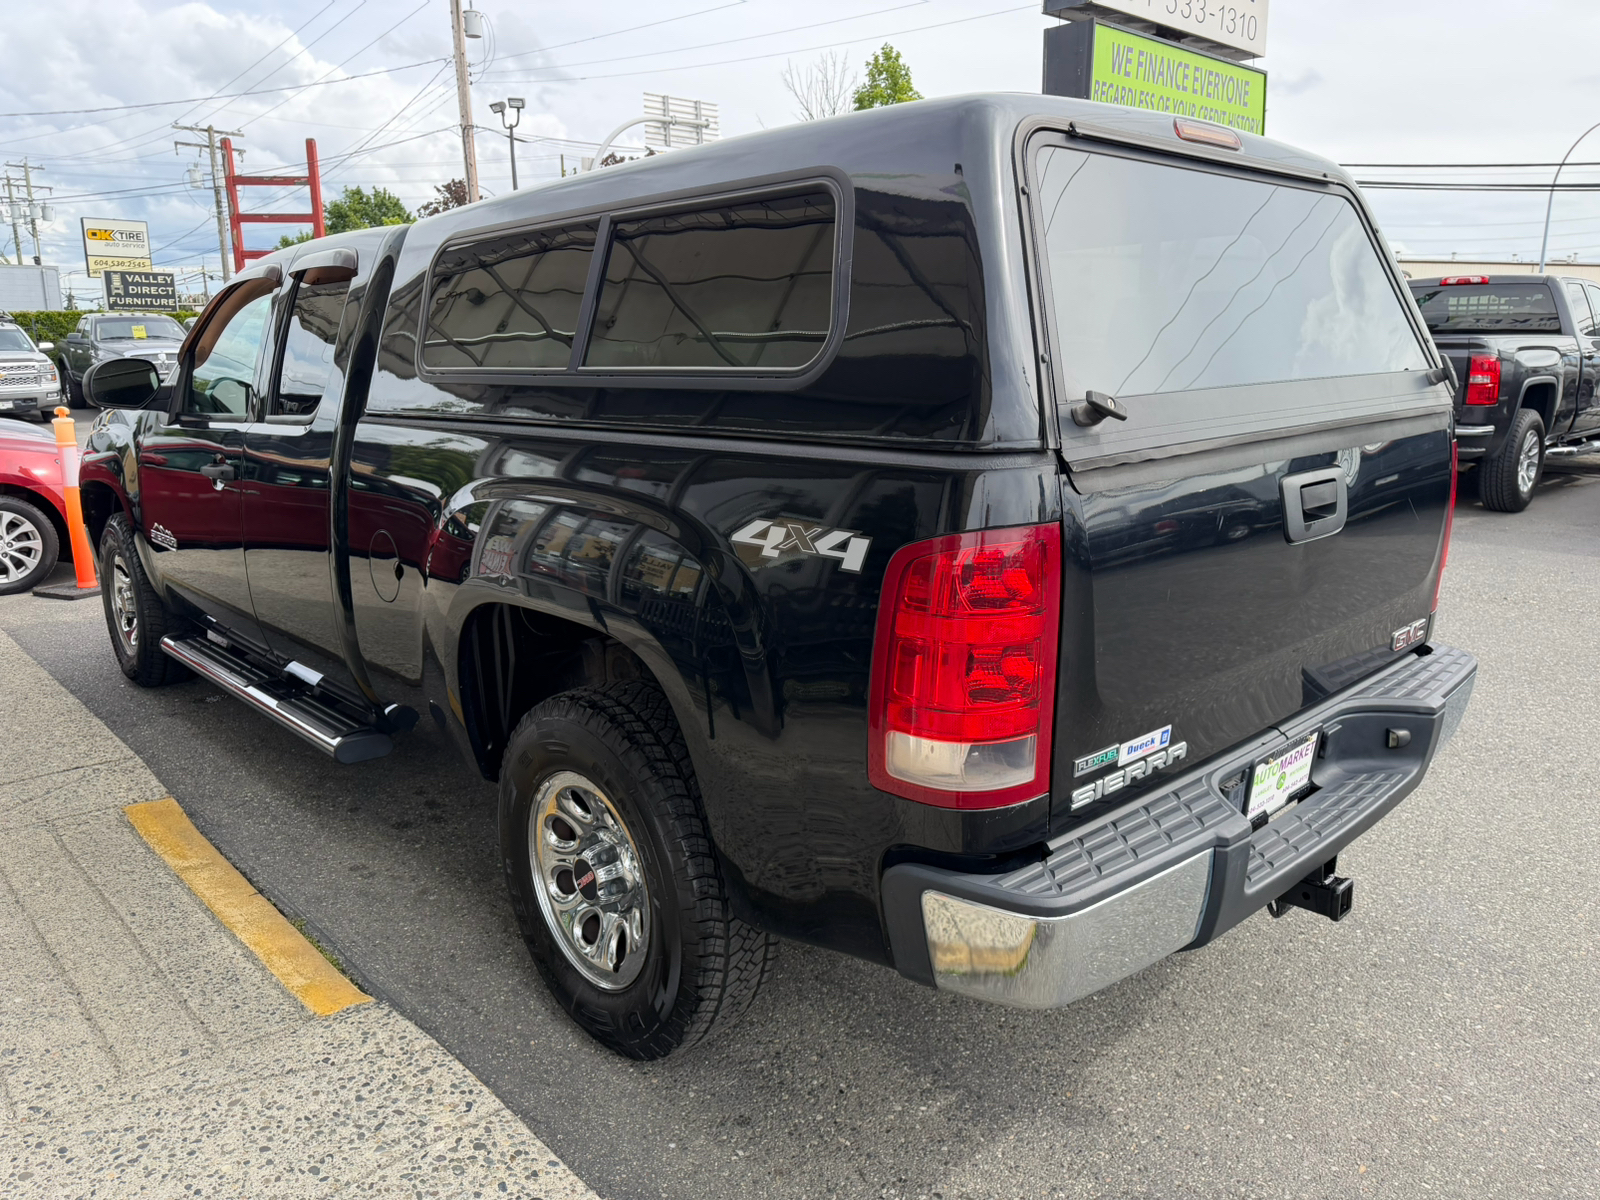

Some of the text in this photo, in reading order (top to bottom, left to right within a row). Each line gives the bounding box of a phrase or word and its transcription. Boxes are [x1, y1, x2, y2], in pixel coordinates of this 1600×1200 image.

[1112, 42, 1250, 108] WE FINANCE EVERYONE
[1093, 79, 1261, 136] REGARDLESS OF YOUR CREDIT HISTORY
[87, 228, 143, 241] OK TIRE
[125, 274, 173, 284] VALLEY
[128, 285, 174, 295] DIRECT
[109, 296, 176, 306] FURNITURE
[1392, 618, 1426, 651] GMC
[1078, 748, 1118, 771] FLEXFUEL
[1071, 741, 1187, 811] SIERRA
[577, 870, 595, 889] GMC
